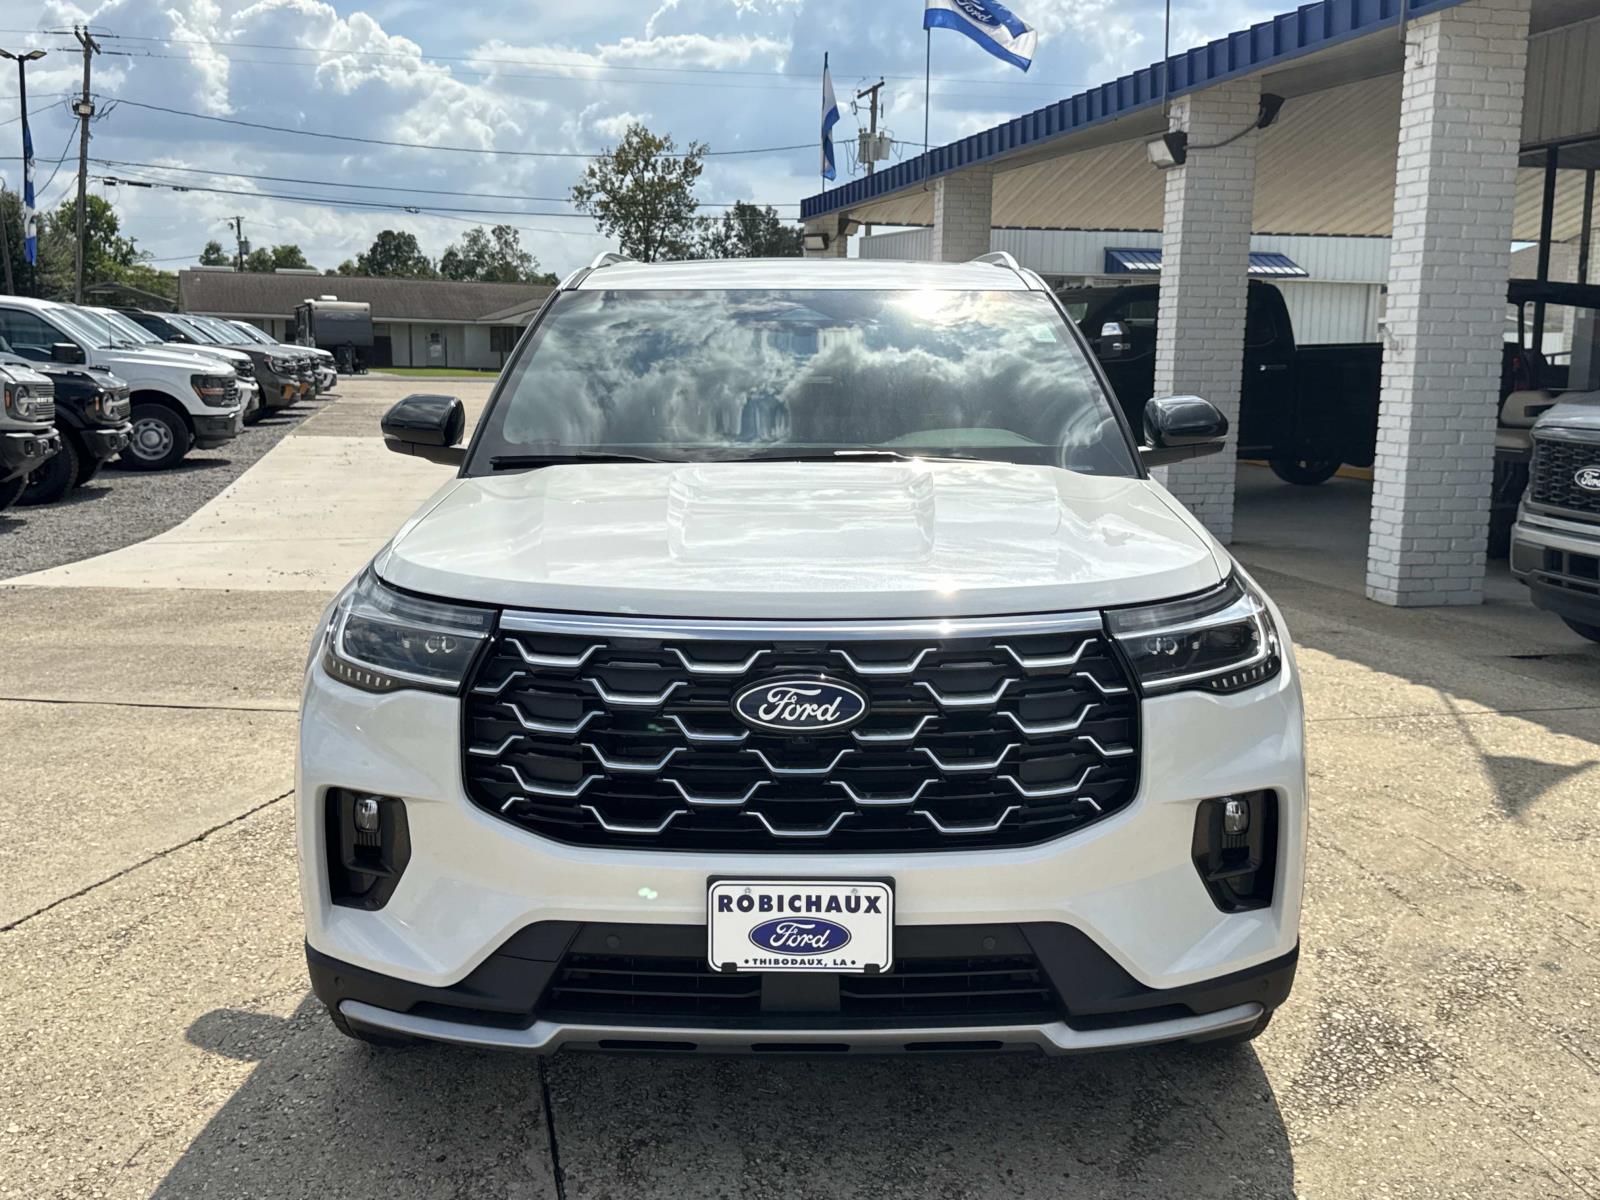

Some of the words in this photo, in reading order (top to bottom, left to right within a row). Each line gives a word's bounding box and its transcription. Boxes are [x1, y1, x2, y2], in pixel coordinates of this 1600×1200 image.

[758, 686, 843, 721] Ford
[717, 894, 882, 914] ROBICHAUX
[769, 921, 831, 948] Ford
[752, 958, 828, 967] THIBODAUX,
[833, 958, 847, 966] LA
